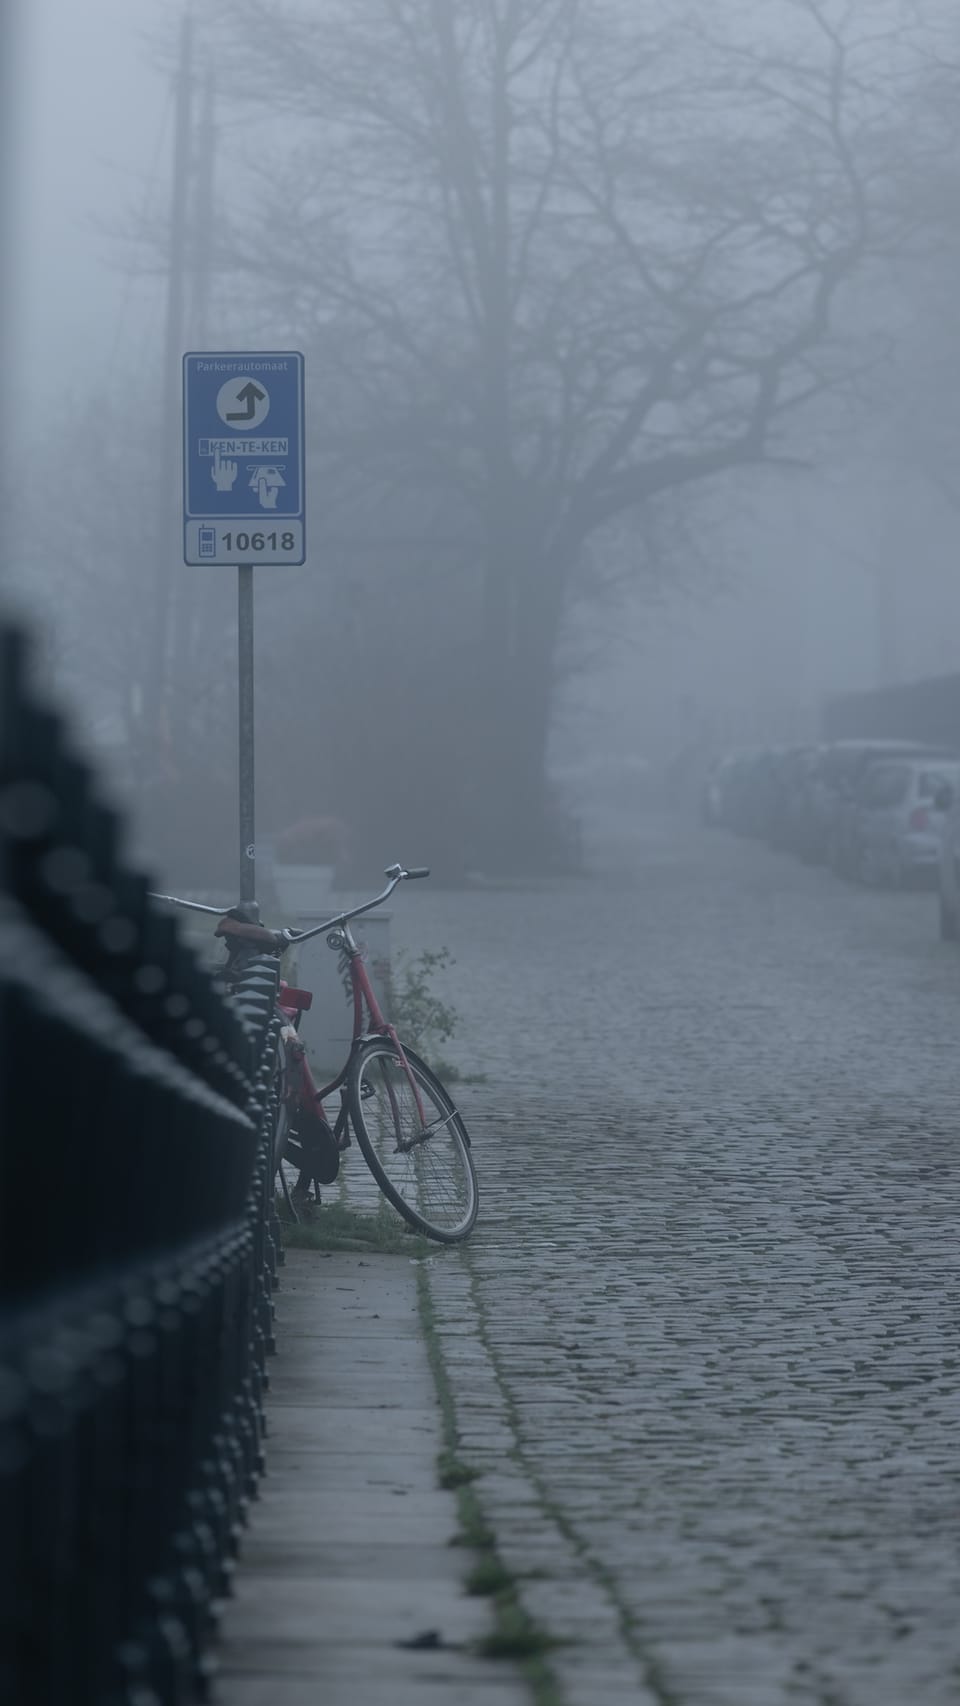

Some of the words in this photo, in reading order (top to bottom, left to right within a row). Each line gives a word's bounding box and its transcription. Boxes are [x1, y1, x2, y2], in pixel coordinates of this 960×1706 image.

[197, 361, 288, 371] Parkeerautomaat
[210, 441, 287, 453] KEN-TE-KEN
[222, 532, 295, 551] 10618
